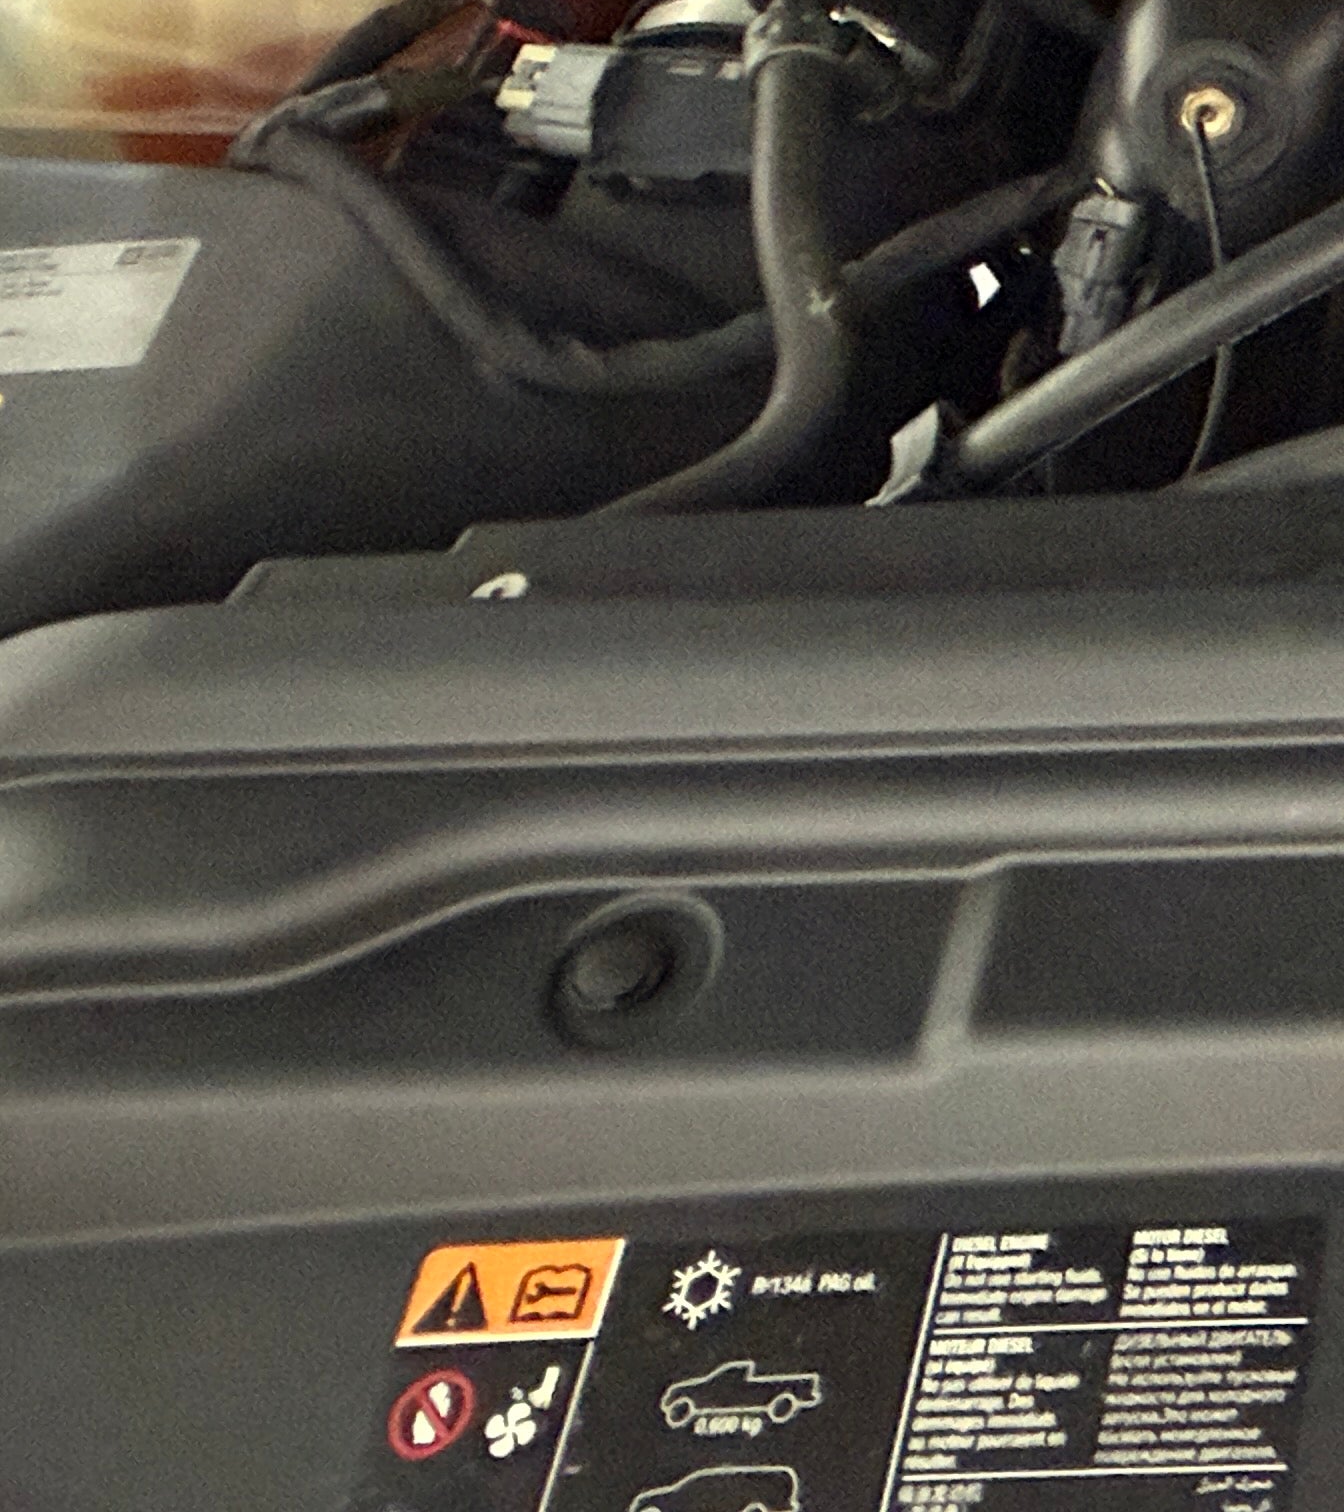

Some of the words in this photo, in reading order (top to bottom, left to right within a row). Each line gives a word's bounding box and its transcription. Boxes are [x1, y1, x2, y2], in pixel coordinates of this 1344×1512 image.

[953, 1236, 997, 1252] DIESEL
[1000, 1234, 1049, 1251] ENGINE
[1133, 1230, 1181, 1245] MOTOR
[1183, 1228, 1229, 1244] DIESEL
[818, 1271, 852, 1292] PAG
[929, 1338, 986, 1355] MOTEUR
[988, 1337, 1034, 1354] DIESEL
